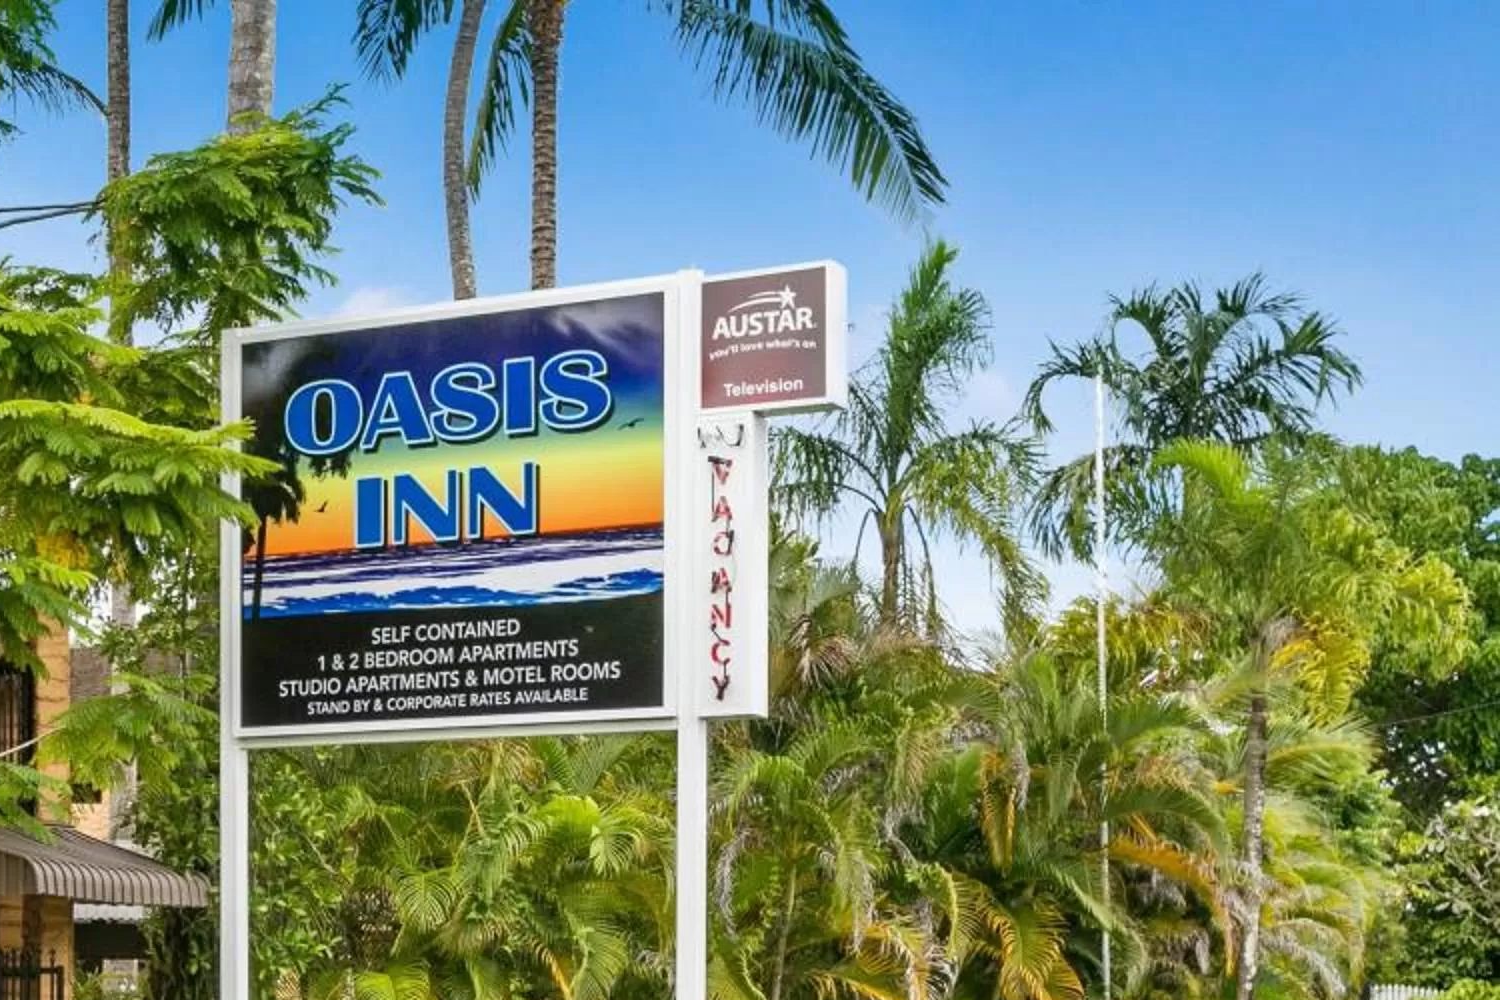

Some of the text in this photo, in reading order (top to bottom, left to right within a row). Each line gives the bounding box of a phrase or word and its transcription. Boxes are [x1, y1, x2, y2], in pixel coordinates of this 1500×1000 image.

[712, 307, 813, 340] AUSTAR
[740, 342, 763, 353] love
[284, 350, 612, 455] OASIS
[724, 377, 804, 397] Television
[355, 461, 538, 549] INN
[711, 456, 733, 701] VACANCY
[371, 619, 521, 645] SELF CONTAINED
[317, 639, 579, 672] 1 & 2 BEDROOM APARTMENTS
[278, 661, 621, 698] STUDIO APARTMENTS & MOTEL ROOMS
[307, 687, 589, 715] STAND BY & CORPORATE RATES AVAILABLE
